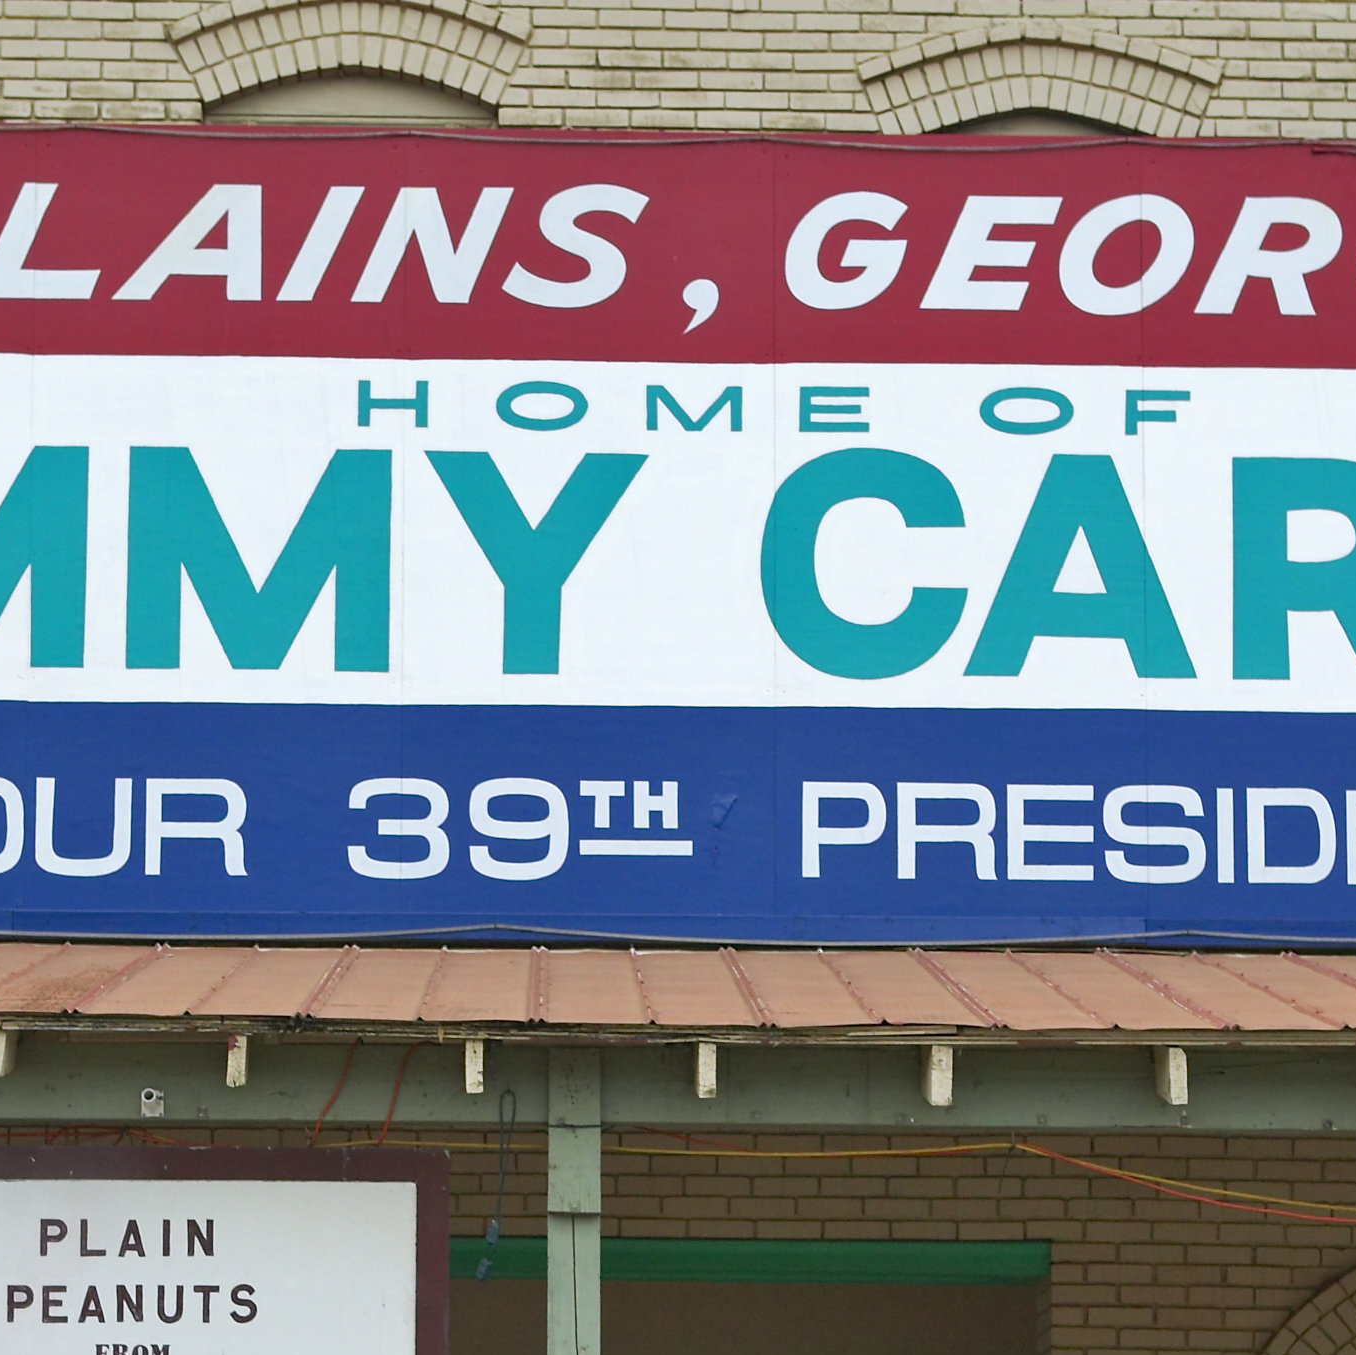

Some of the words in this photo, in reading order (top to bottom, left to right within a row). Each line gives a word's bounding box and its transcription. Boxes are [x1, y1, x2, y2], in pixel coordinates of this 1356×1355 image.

[357, 379, 870, 433] HOME
[979, 386, 1192, 436] OF
[347, 777, 694, 881] 39TH
[39, 1218, 215, 1257] PLAIN
[6, 1284, 259, 1324] PEANUTS
